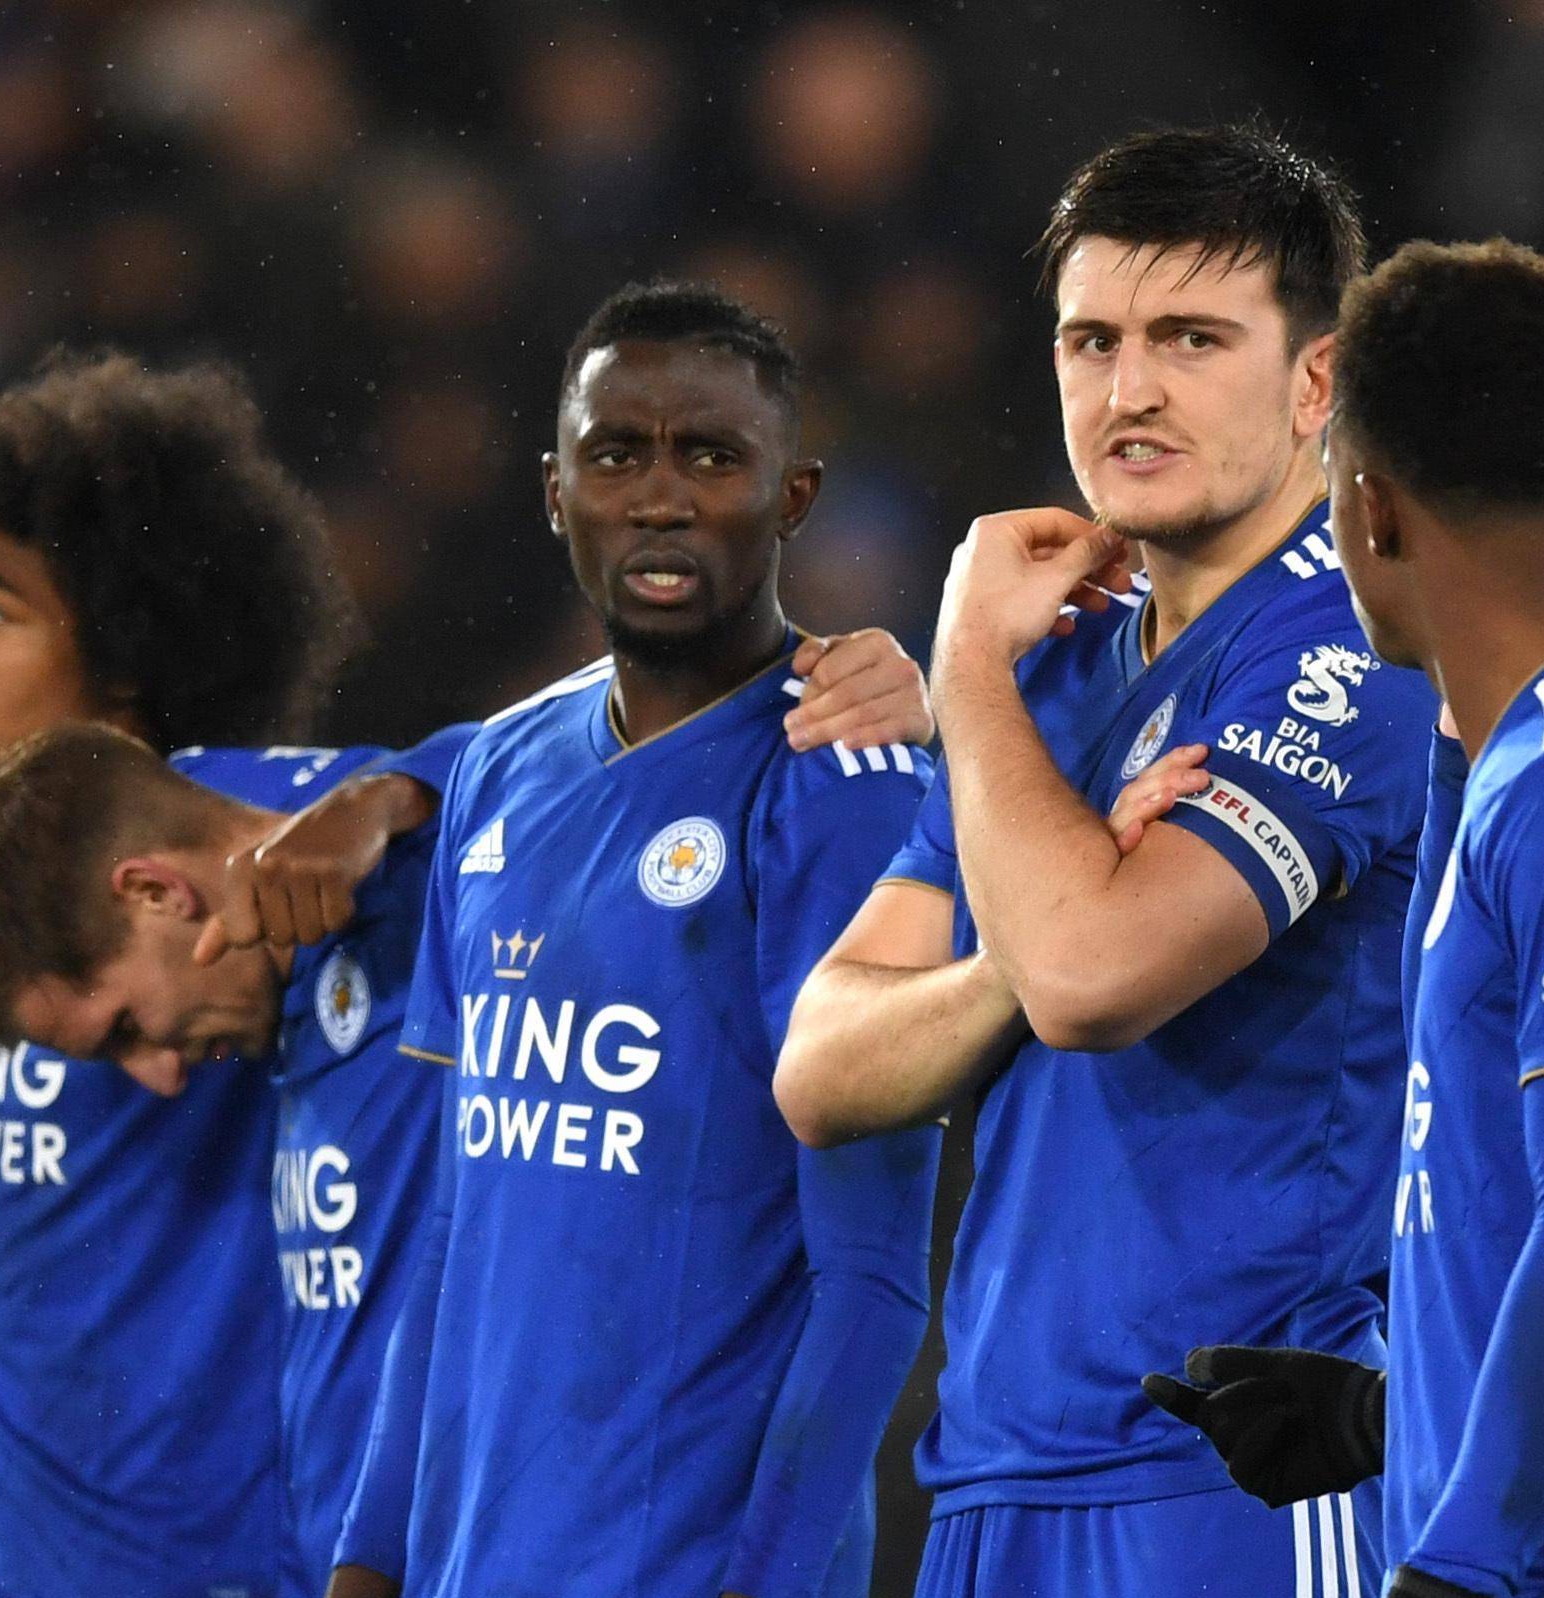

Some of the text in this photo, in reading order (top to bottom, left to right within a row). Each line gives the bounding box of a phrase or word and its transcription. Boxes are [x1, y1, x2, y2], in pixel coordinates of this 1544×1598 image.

[1217, 723, 1353, 801] SAIGON
[1276, 717, 1321, 751] BIA
[1210, 788, 1312, 910] EFL CAPTAIN
[460, 992, 661, 1094] KING
